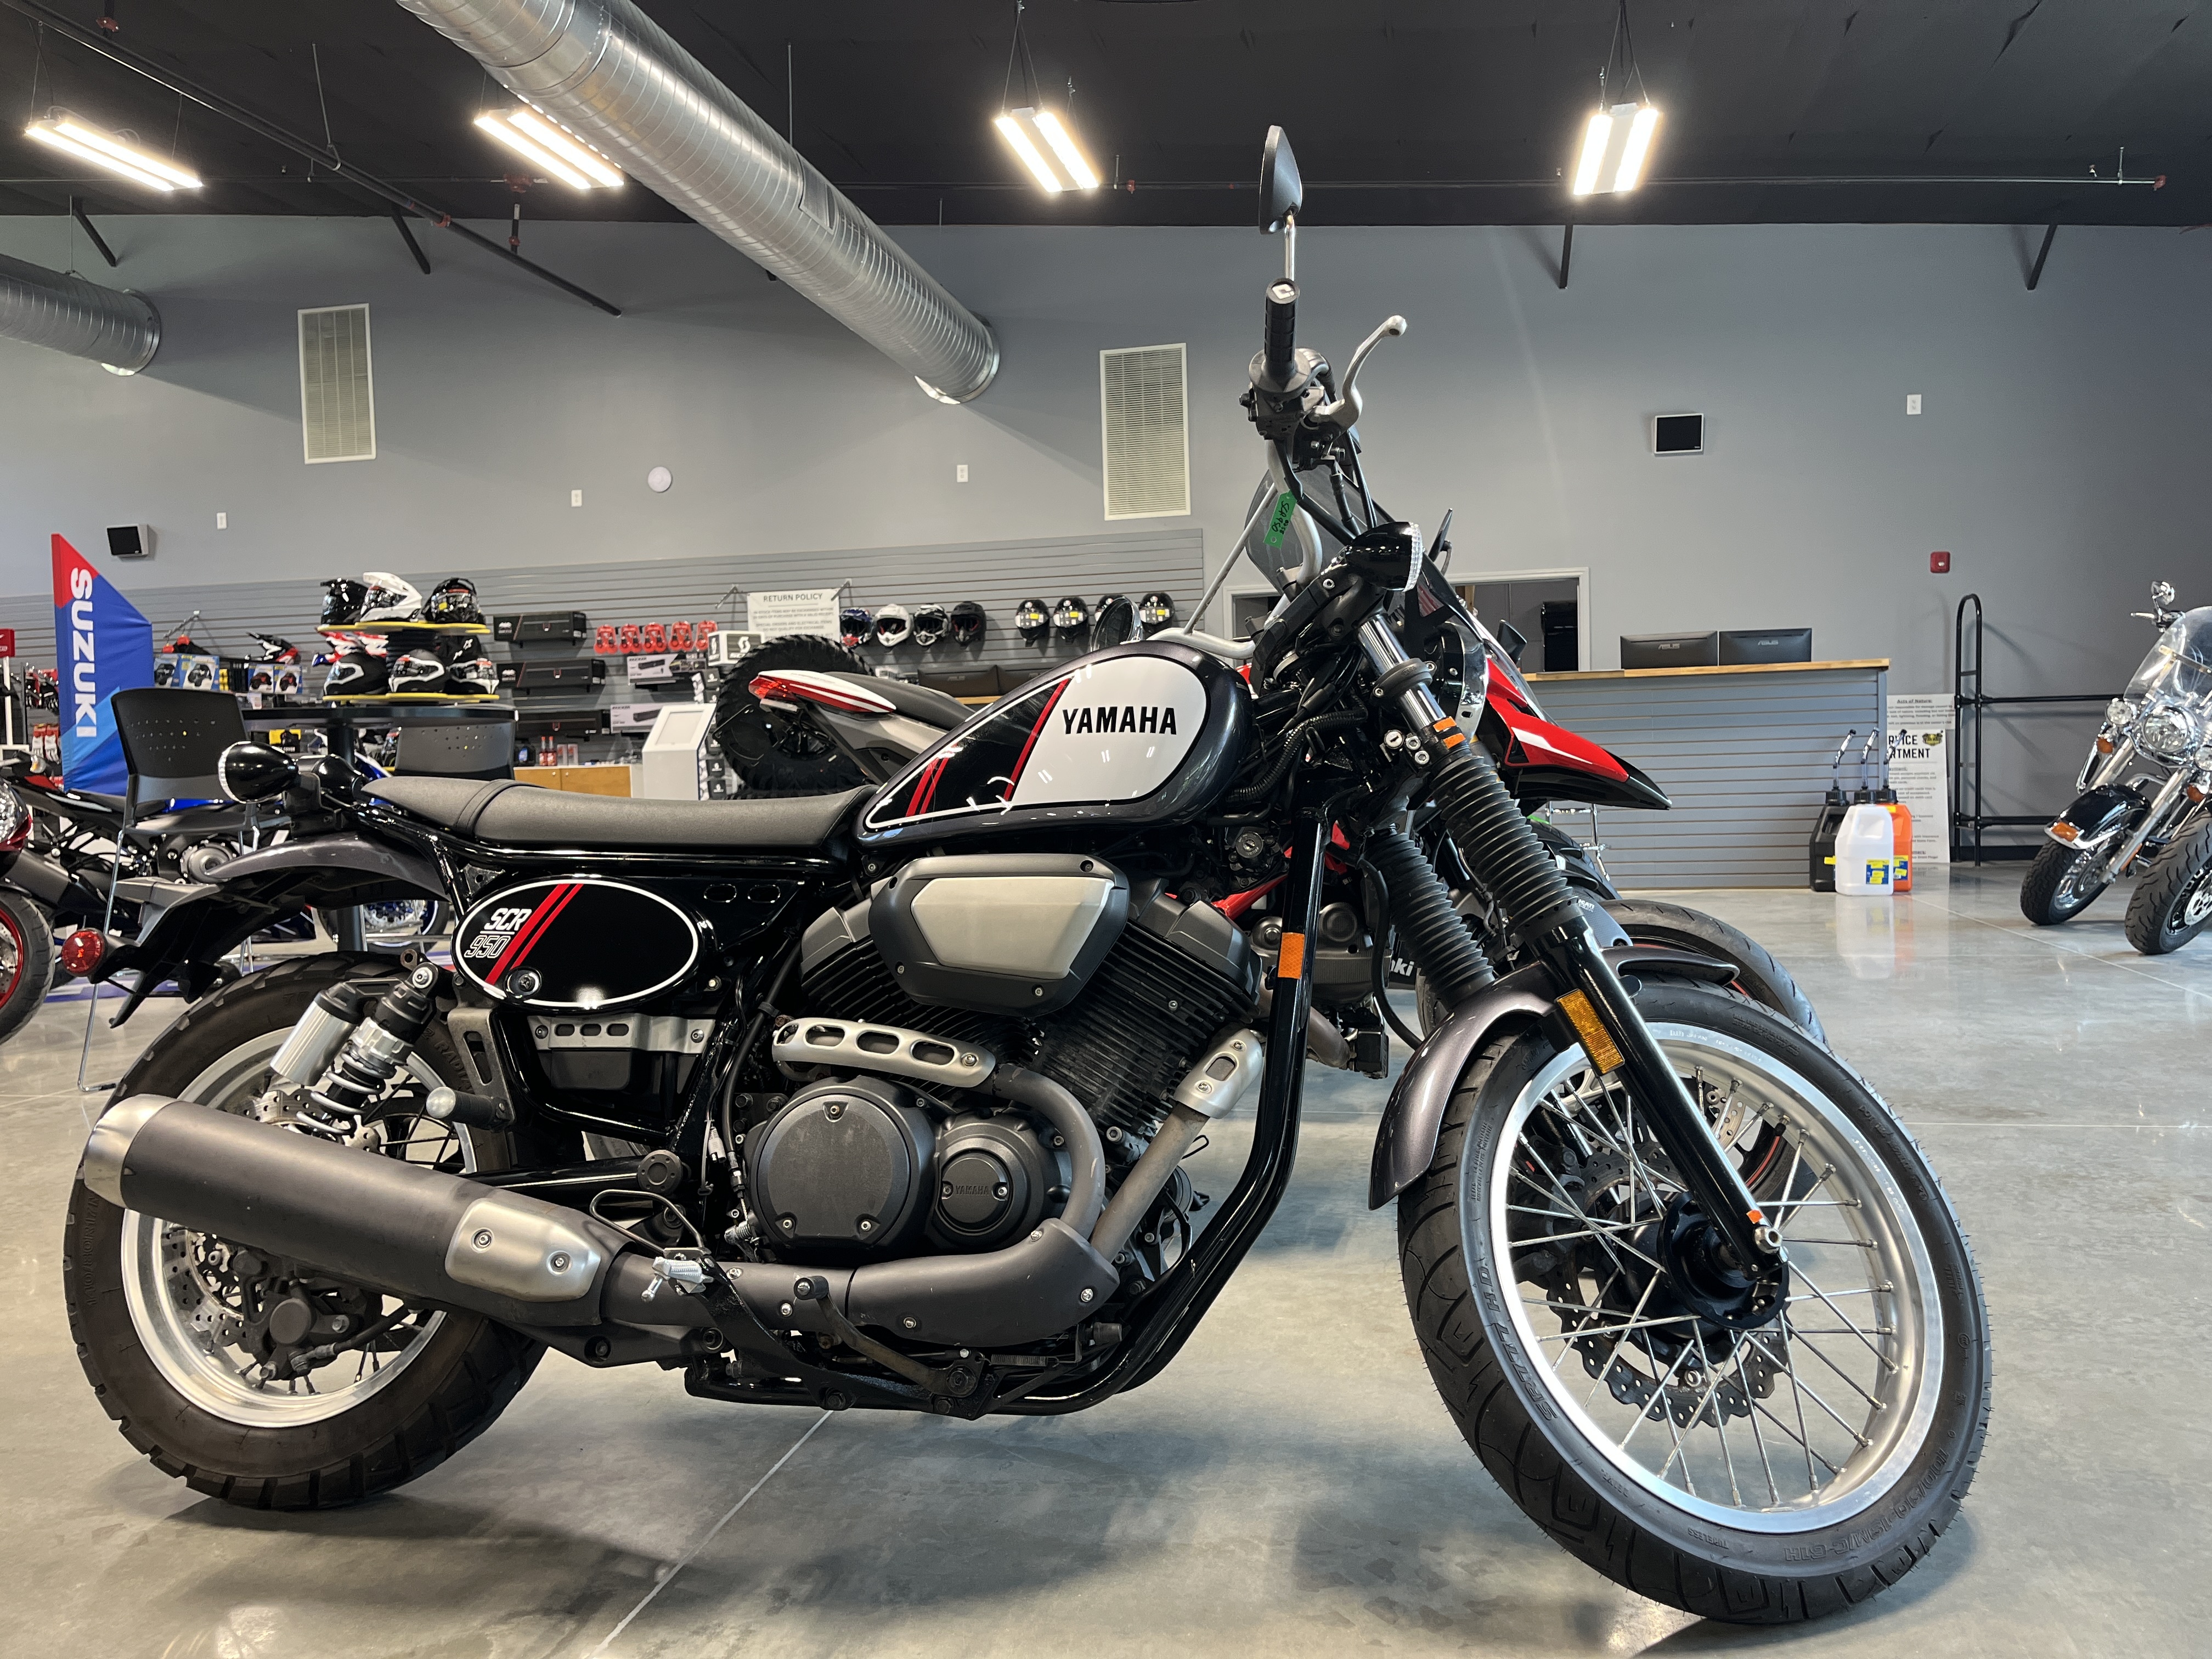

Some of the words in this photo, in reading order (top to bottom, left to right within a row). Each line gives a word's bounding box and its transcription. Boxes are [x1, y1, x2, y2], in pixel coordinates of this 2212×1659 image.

[1271, 517, 1283, 532] 950
[763, 594, 793, 602] RETURN
[70, 567, 98, 737] SUZUKI
[1062, 706, 1177, 735] YAMAHA
[484, 908, 532, 931] SCR
[464, 935, 511, 958] 950
[955, 1185, 990, 1196] YAMAHA
[1688, 1527, 1730, 1550] TUBELESS
